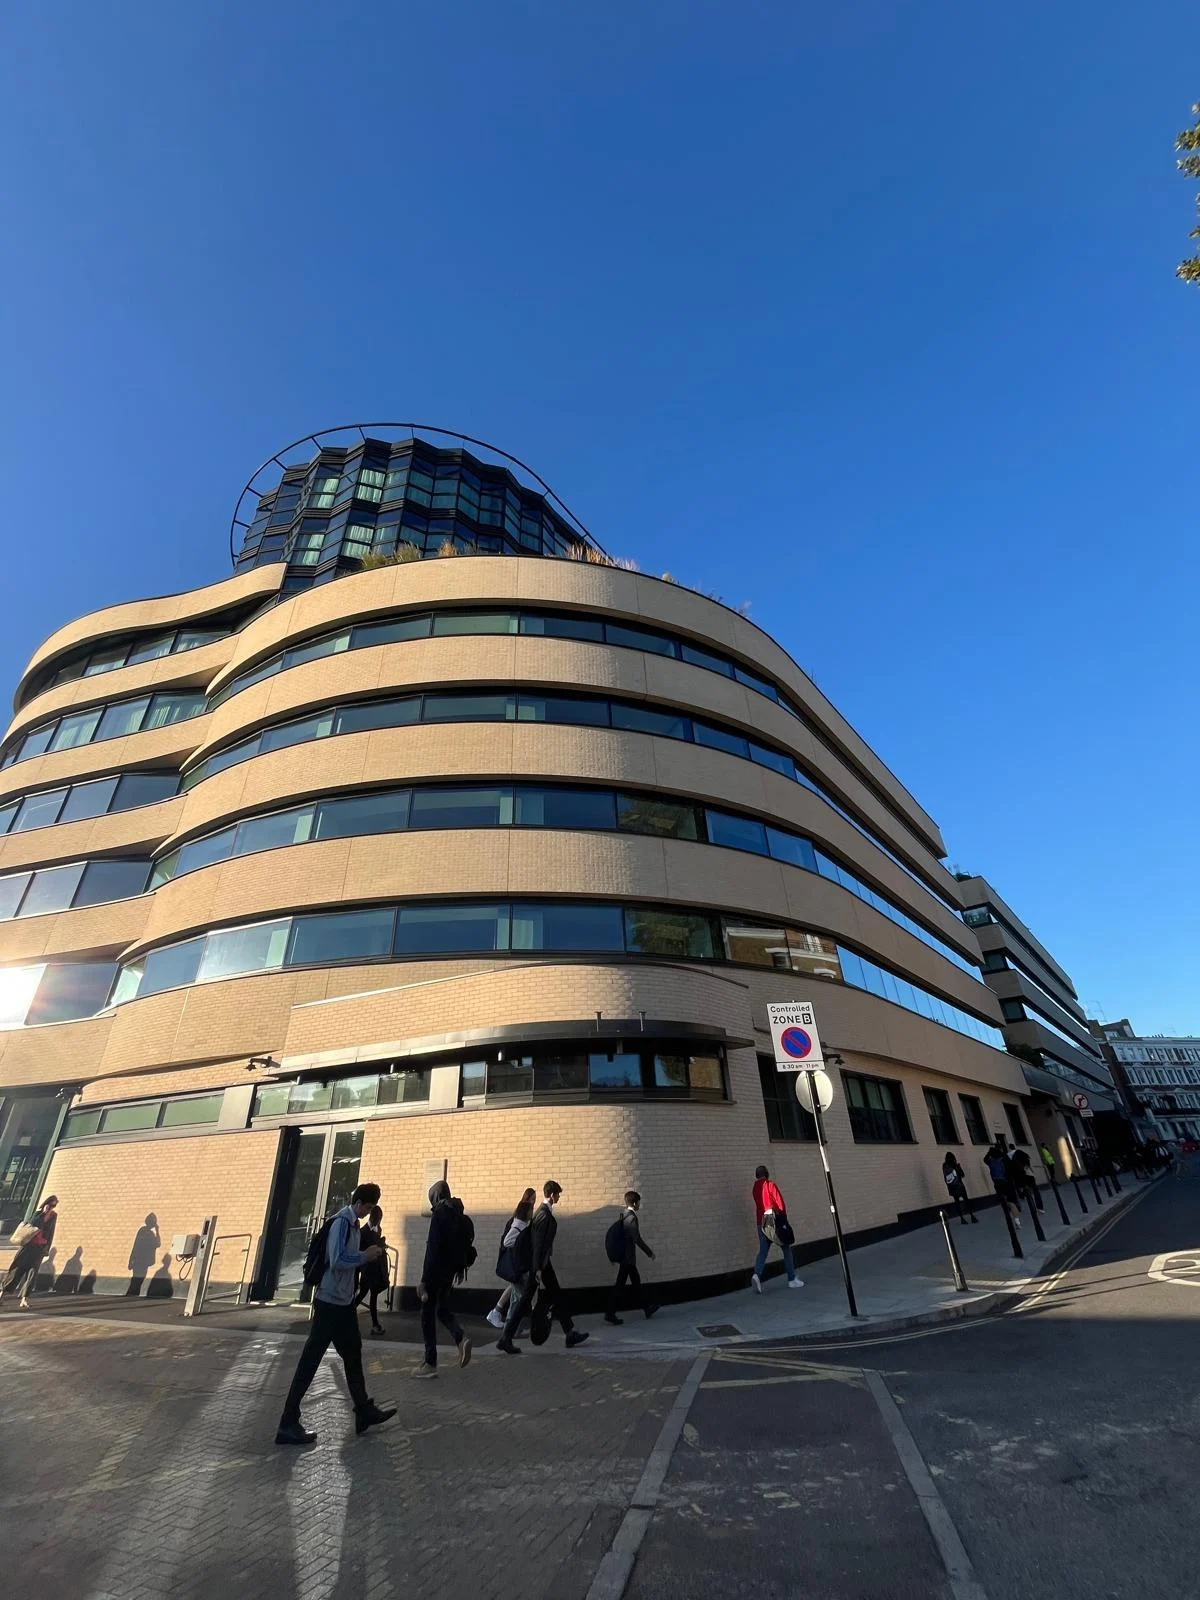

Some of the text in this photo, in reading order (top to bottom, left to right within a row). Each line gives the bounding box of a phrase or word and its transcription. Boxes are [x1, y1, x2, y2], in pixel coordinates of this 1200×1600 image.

[770, 1005, 810, 1013] Controlled
[772, 1014, 812, 1024] ZONE B
